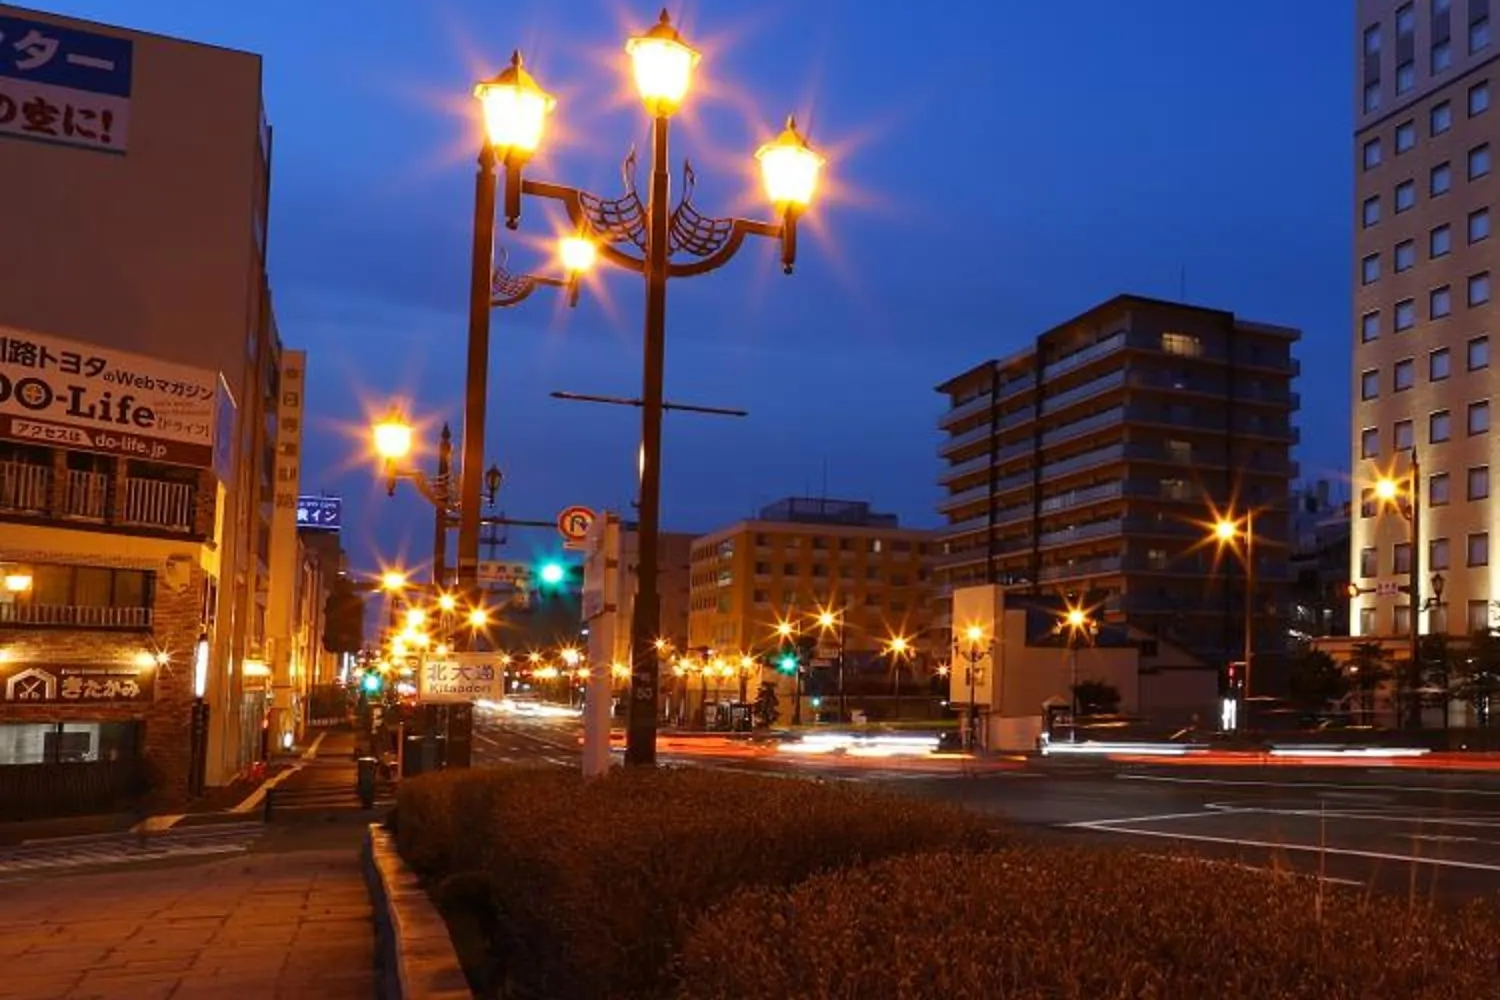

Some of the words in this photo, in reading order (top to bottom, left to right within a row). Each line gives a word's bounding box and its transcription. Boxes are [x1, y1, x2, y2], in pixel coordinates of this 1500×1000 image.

[0, 29, 115, 71] ター
[17, 423, 81, 442] アクセスは
[427, 663, 495, 681] 北大通
